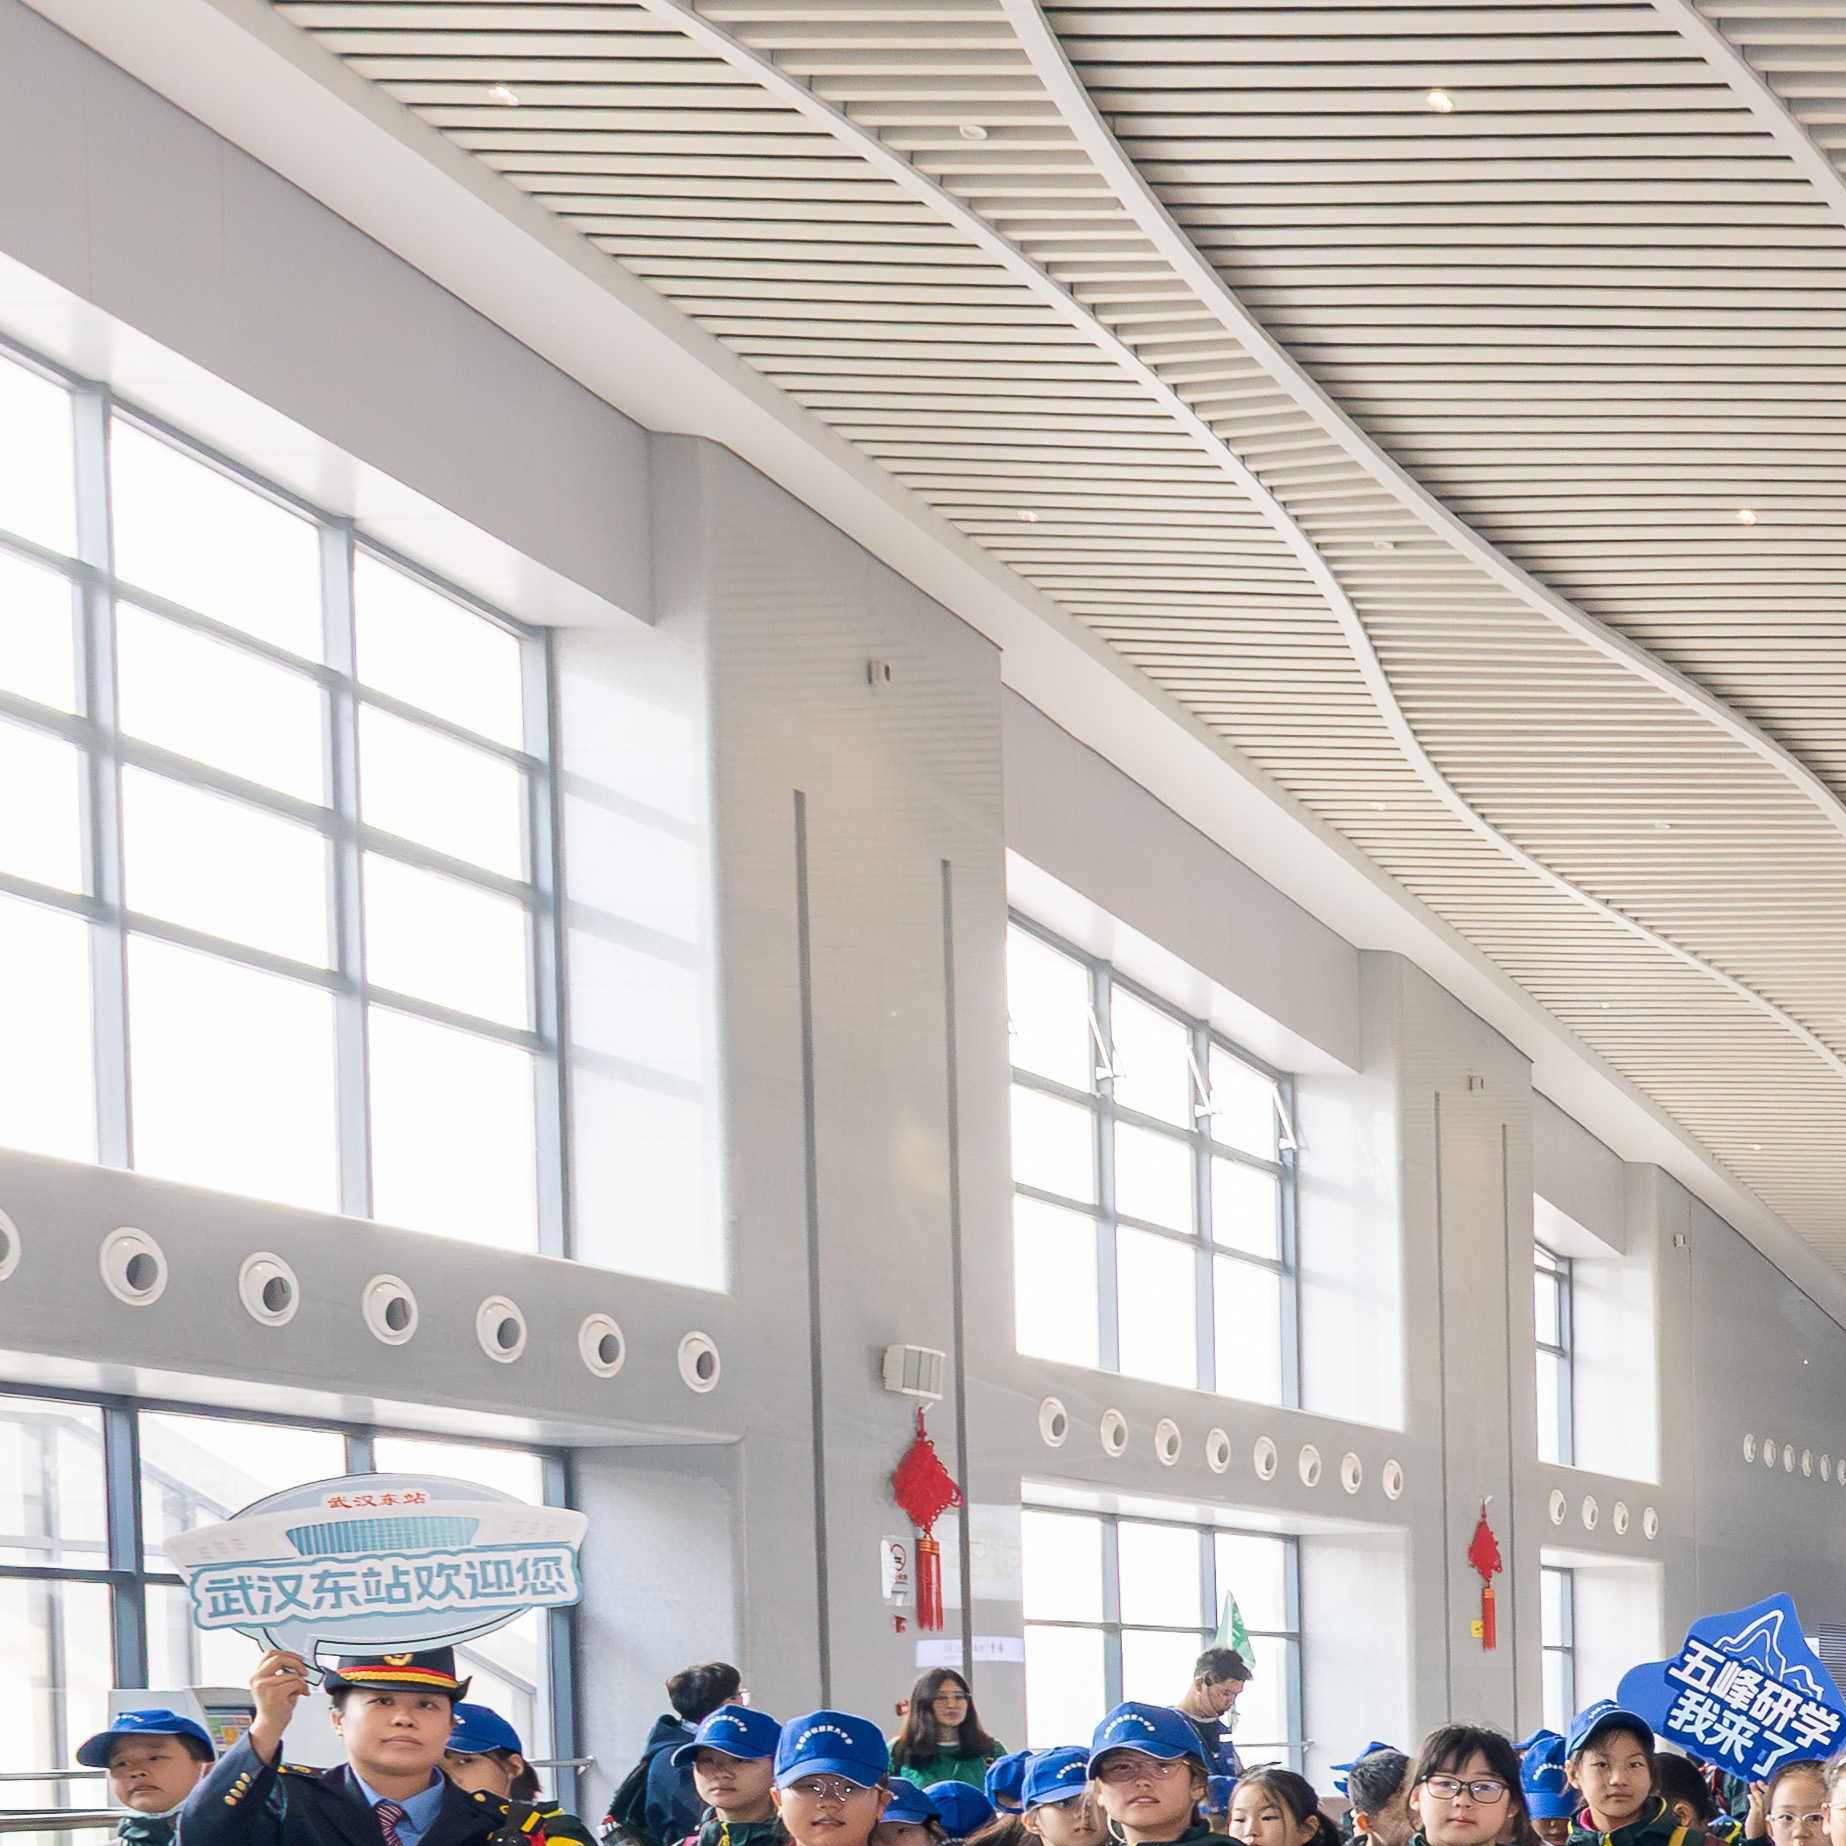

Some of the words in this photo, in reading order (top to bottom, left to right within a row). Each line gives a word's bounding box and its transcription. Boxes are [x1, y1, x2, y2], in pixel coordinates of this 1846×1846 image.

[327, 1490, 428, 1511] 武汉东站
[204, 1554, 568, 1620] 武汉东站欢迎您
[1668, 1639, 1841, 1749] 五峰研学
[1667, 1689, 1798, 1777] 我来了
